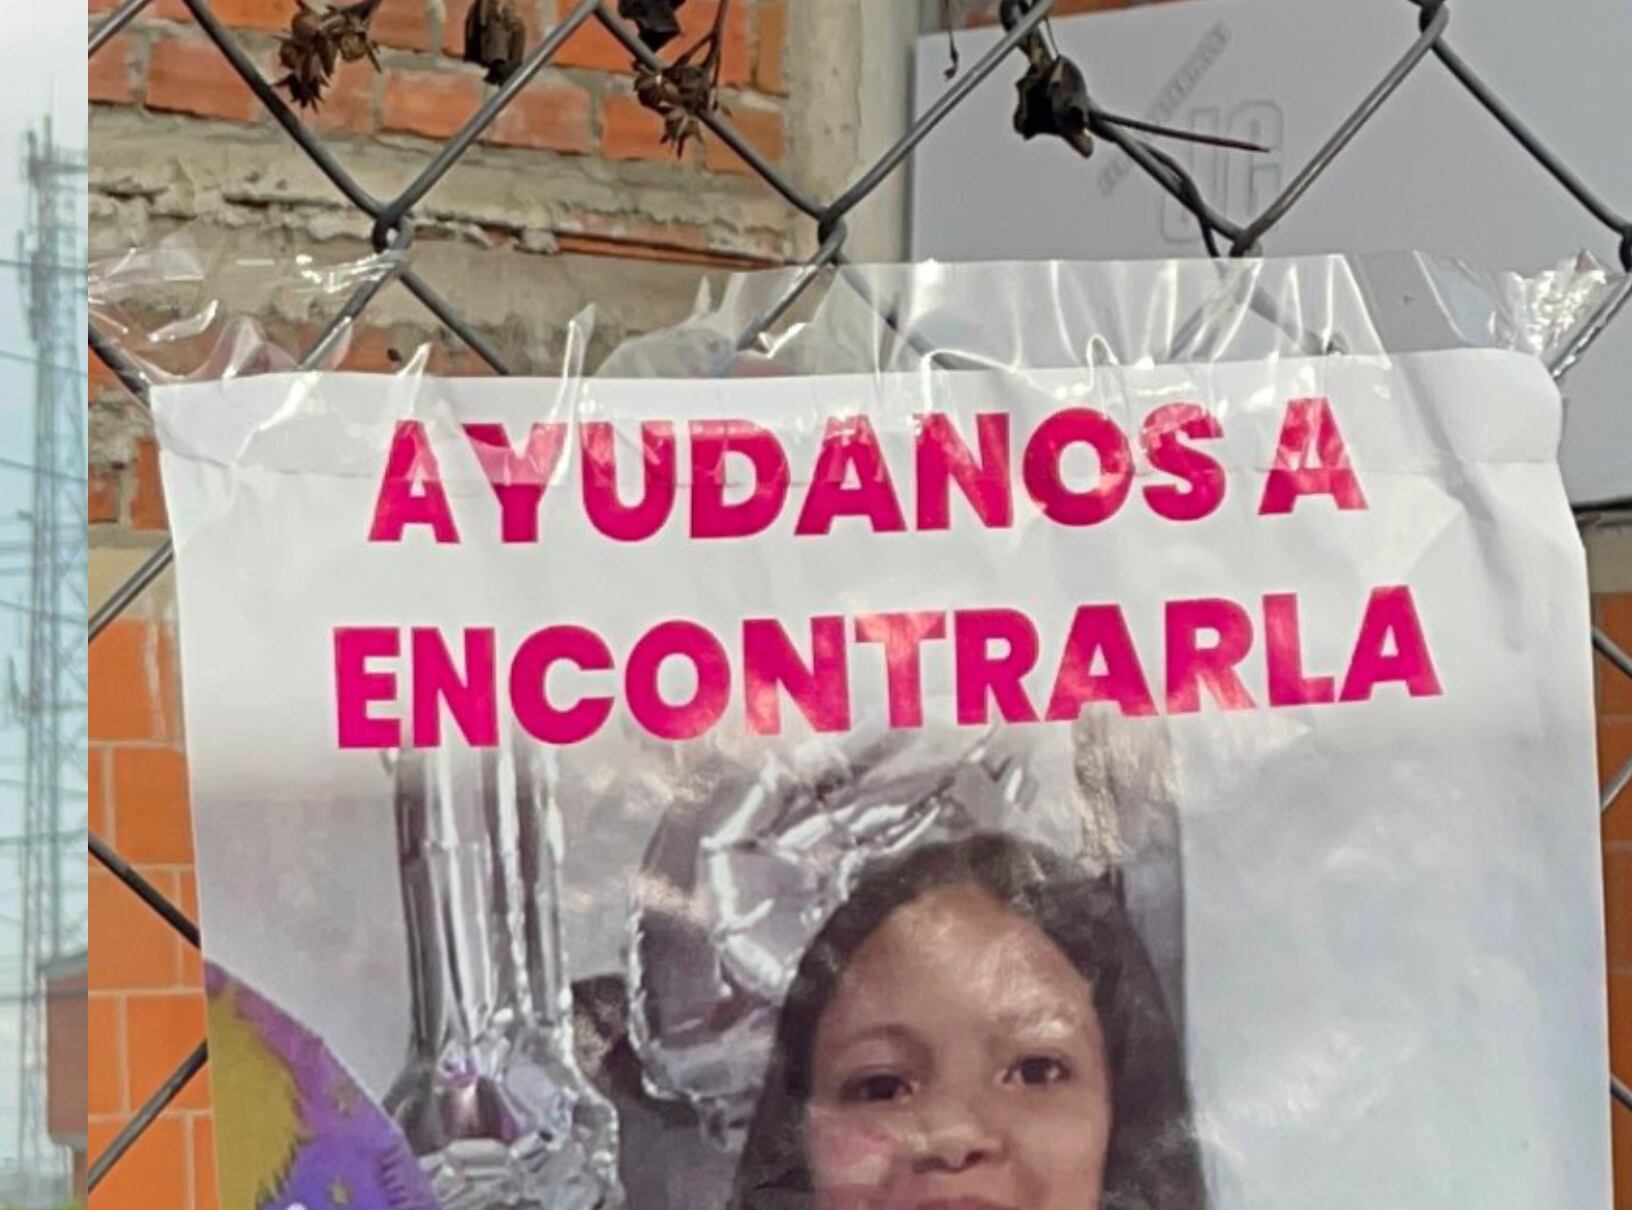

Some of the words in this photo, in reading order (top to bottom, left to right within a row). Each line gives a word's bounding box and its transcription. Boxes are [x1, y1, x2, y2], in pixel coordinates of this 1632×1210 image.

[368, 402, 1227, 545] AYUDANOS
[1258, 397, 1367, 517] A
[333, 585, 1443, 751] ENCONTRARLA
